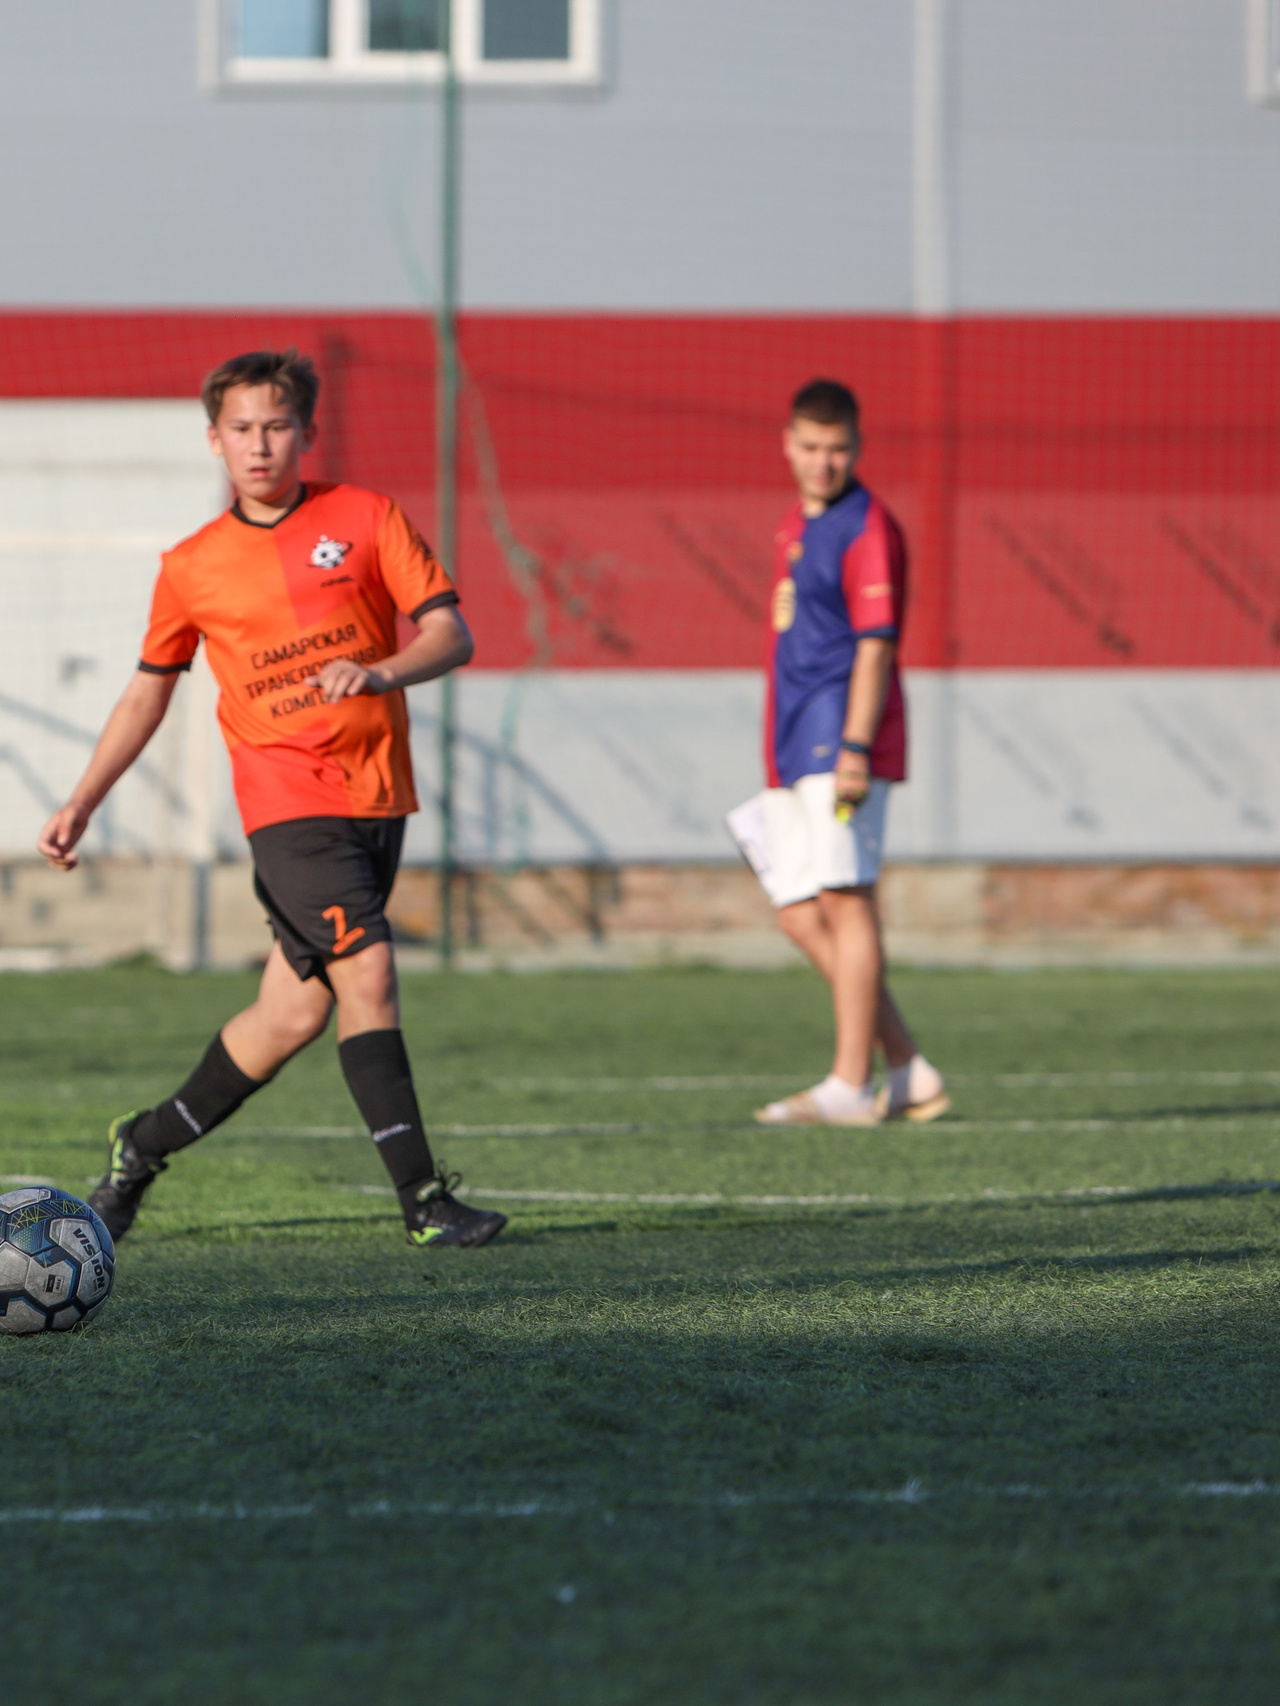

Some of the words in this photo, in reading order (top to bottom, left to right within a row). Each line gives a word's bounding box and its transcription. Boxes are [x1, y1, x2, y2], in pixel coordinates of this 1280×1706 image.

[251, 623, 357, 670] САМАРСКАЯ
[244, 646, 377, 699] ТРАНСПОНАЯ
[322, 905, 366, 955] 2
[72, 1227, 106, 1291] VISION
